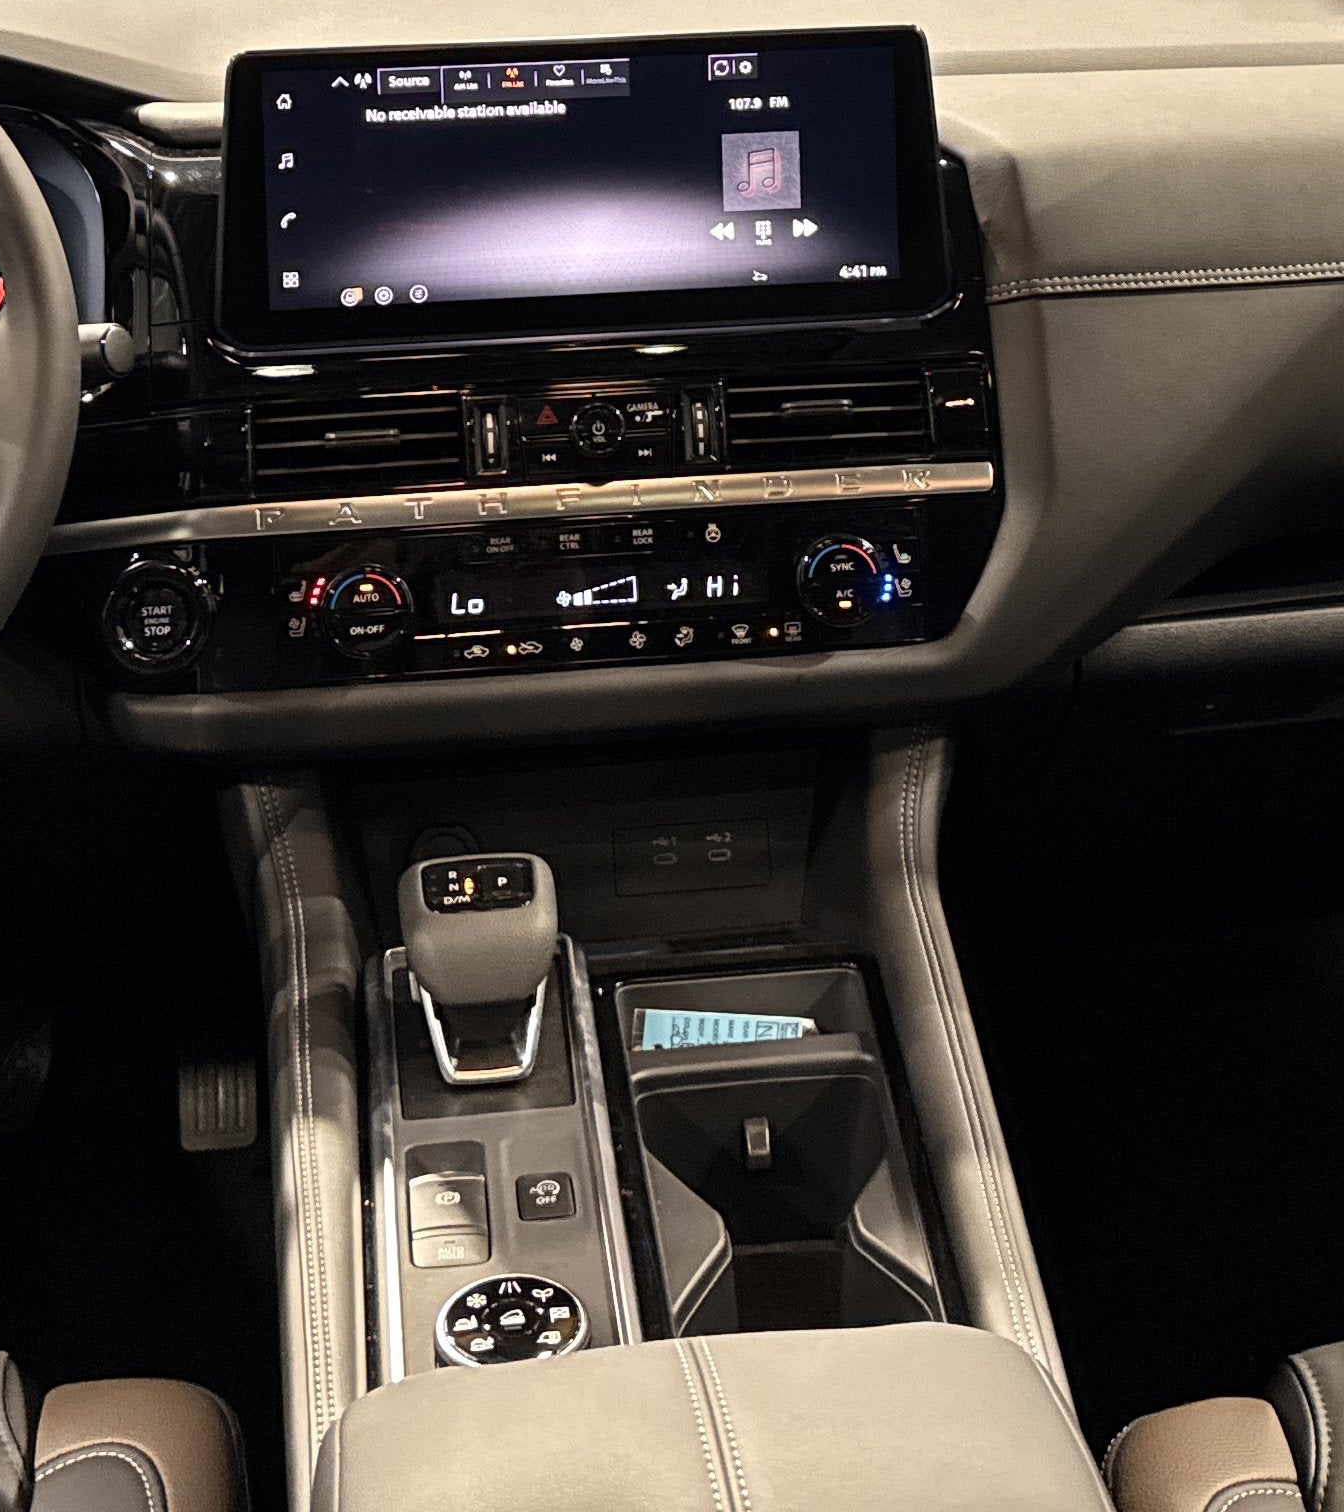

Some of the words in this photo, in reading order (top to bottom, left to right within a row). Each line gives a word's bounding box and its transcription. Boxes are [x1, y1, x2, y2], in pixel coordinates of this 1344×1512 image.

[388, 75, 431, 88] Source
[729, 97, 763, 110] 107.9
[769, 96, 790, 108] FM
[365, 108, 386, 123] No
[388, 105, 456, 122] receivable
[457, 102, 504, 118] station
[506, 100, 567, 116] available
[839, 265, 868, 278] 4:41
[869, 266, 888, 276] PM
[626, 402, 659, 413] CAMERA
[593, 435, 607, 443] VOL
[255, 469, 932, 531] PATHFINDER
[559, 534, 581, 542] REAR
[632, 528, 654, 537] REAR
[489, 537, 512, 545] REAR
[559, 542, 581, 550] CTRL
[632, 537, 654, 545] LOCK
[830, 561, 856, 572] SYNC
[706, 574, 739, 598] Hi
[353, 592, 380, 604] AUTO
[835, 588, 854, 599] A/C
[450, 593, 485, 615] Lo
[141, 605, 173, 617] START
[144, 616, 170, 625] ENGINE
[144, 625, 172, 637] STOP
[349, 624, 385, 636] ON-OFF
[448, 870, 458, 880] R
[497, 876, 508, 887] P
[448, 883, 459, 892] N
[443, 895, 471, 905] D/M
[535, 1196, 557, 1205] OFF
[438, 1246, 465, 1254] AUTO
[438, 1253, 465, 1261] HOLD
